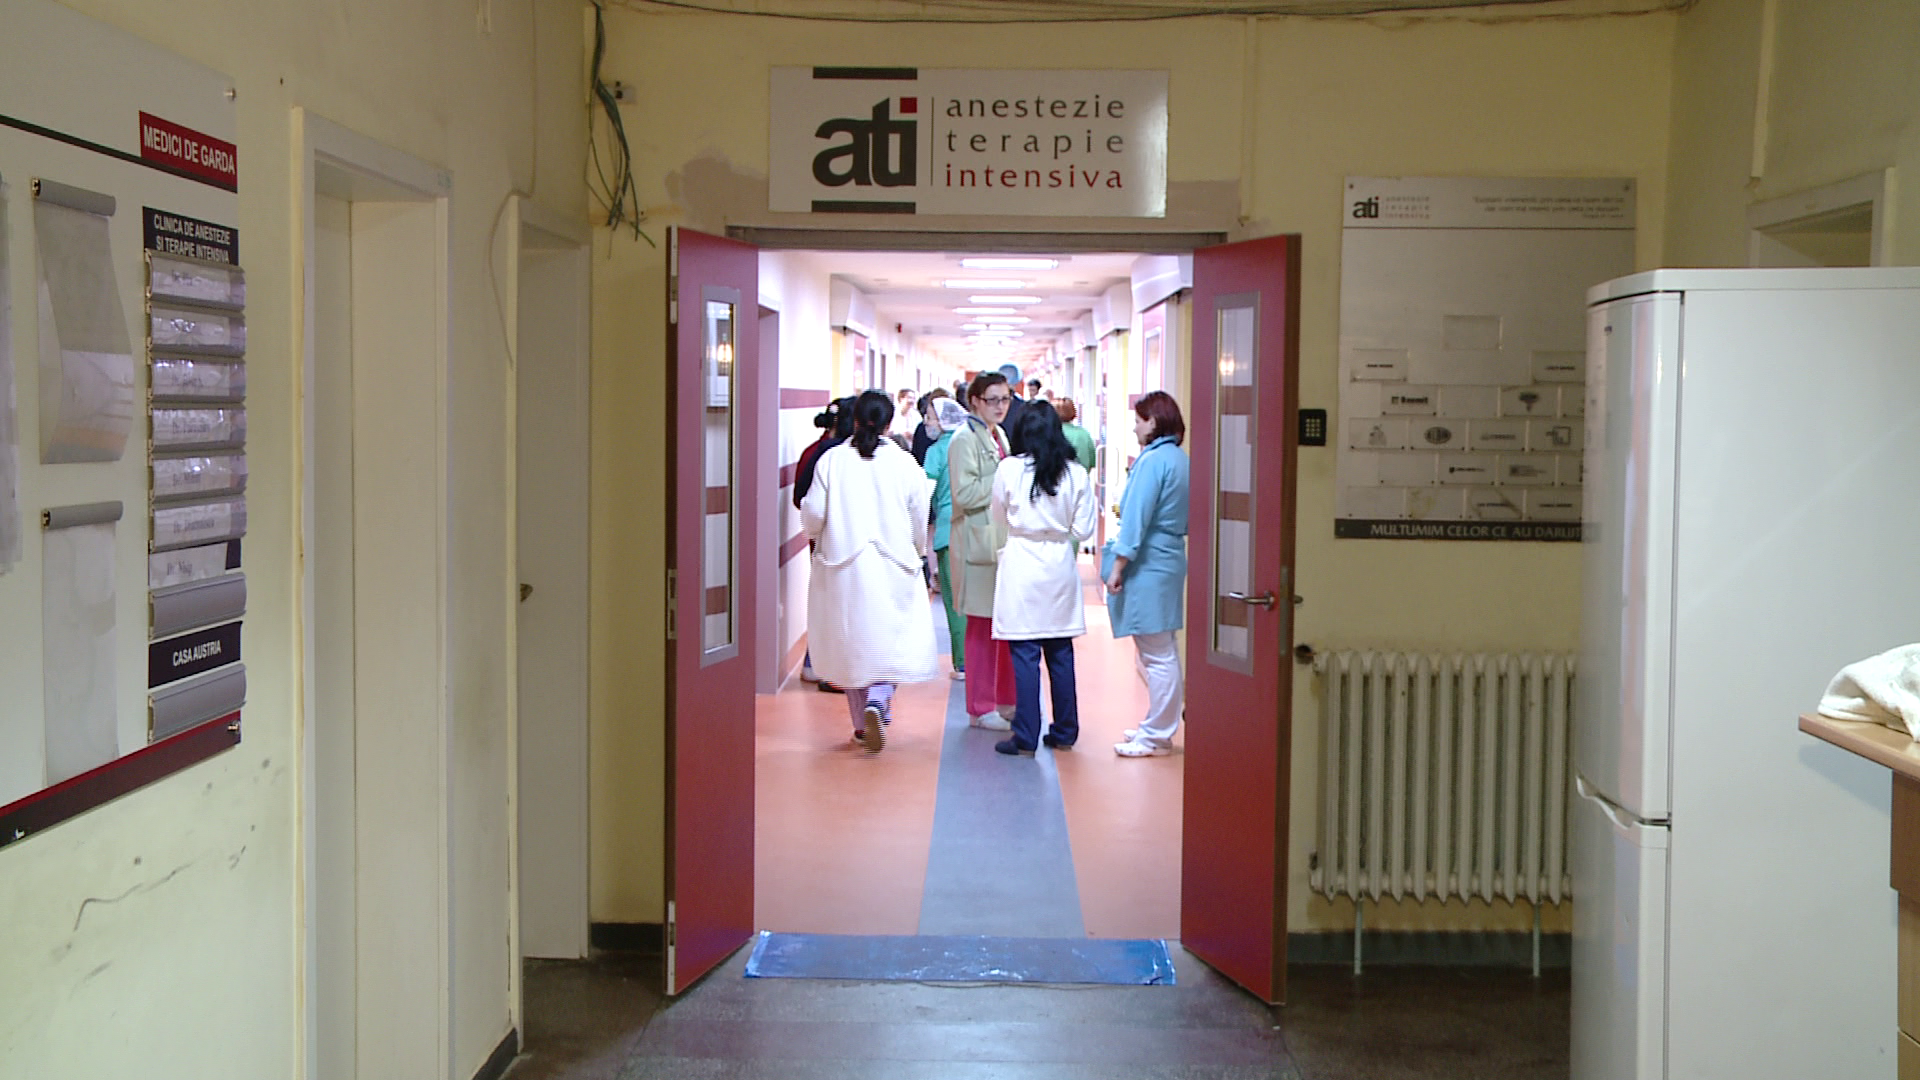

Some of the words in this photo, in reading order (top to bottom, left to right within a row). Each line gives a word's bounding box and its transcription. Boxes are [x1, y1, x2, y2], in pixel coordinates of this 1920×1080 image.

[946, 95, 1125, 119] anestezie
[143, 124, 182, 158] MEDICI
[184, 139, 199, 163] DE
[200, 145, 235, 175] GARDA
[811, 97, 918, 187] ati
[946, 129, 1125, 159] terapie
[945, 163, 1123, 189] intensiva
[1352, 196, 1379, 218] ati
[154, 214, 183, 235] CLINICA
[184, 221, 194, 237] DE
[195, 224, 230, 245] ANESTEZIE
[156, 235, 164, 251] SI
[165, 237, 195, 257] TERAPIE
[196, 243, 230, 264] INTENSIVA
[1370, 524, 1444, 536] MULTUMIM
[1447, 525, 1489, 537] CELOR
[1491, 526, 1507, 537] CE
[1511, 527, 1531, 537] AU
[173, 648, 193, 667] CASA
[193, 639, 222, 661] AUSTRIA
